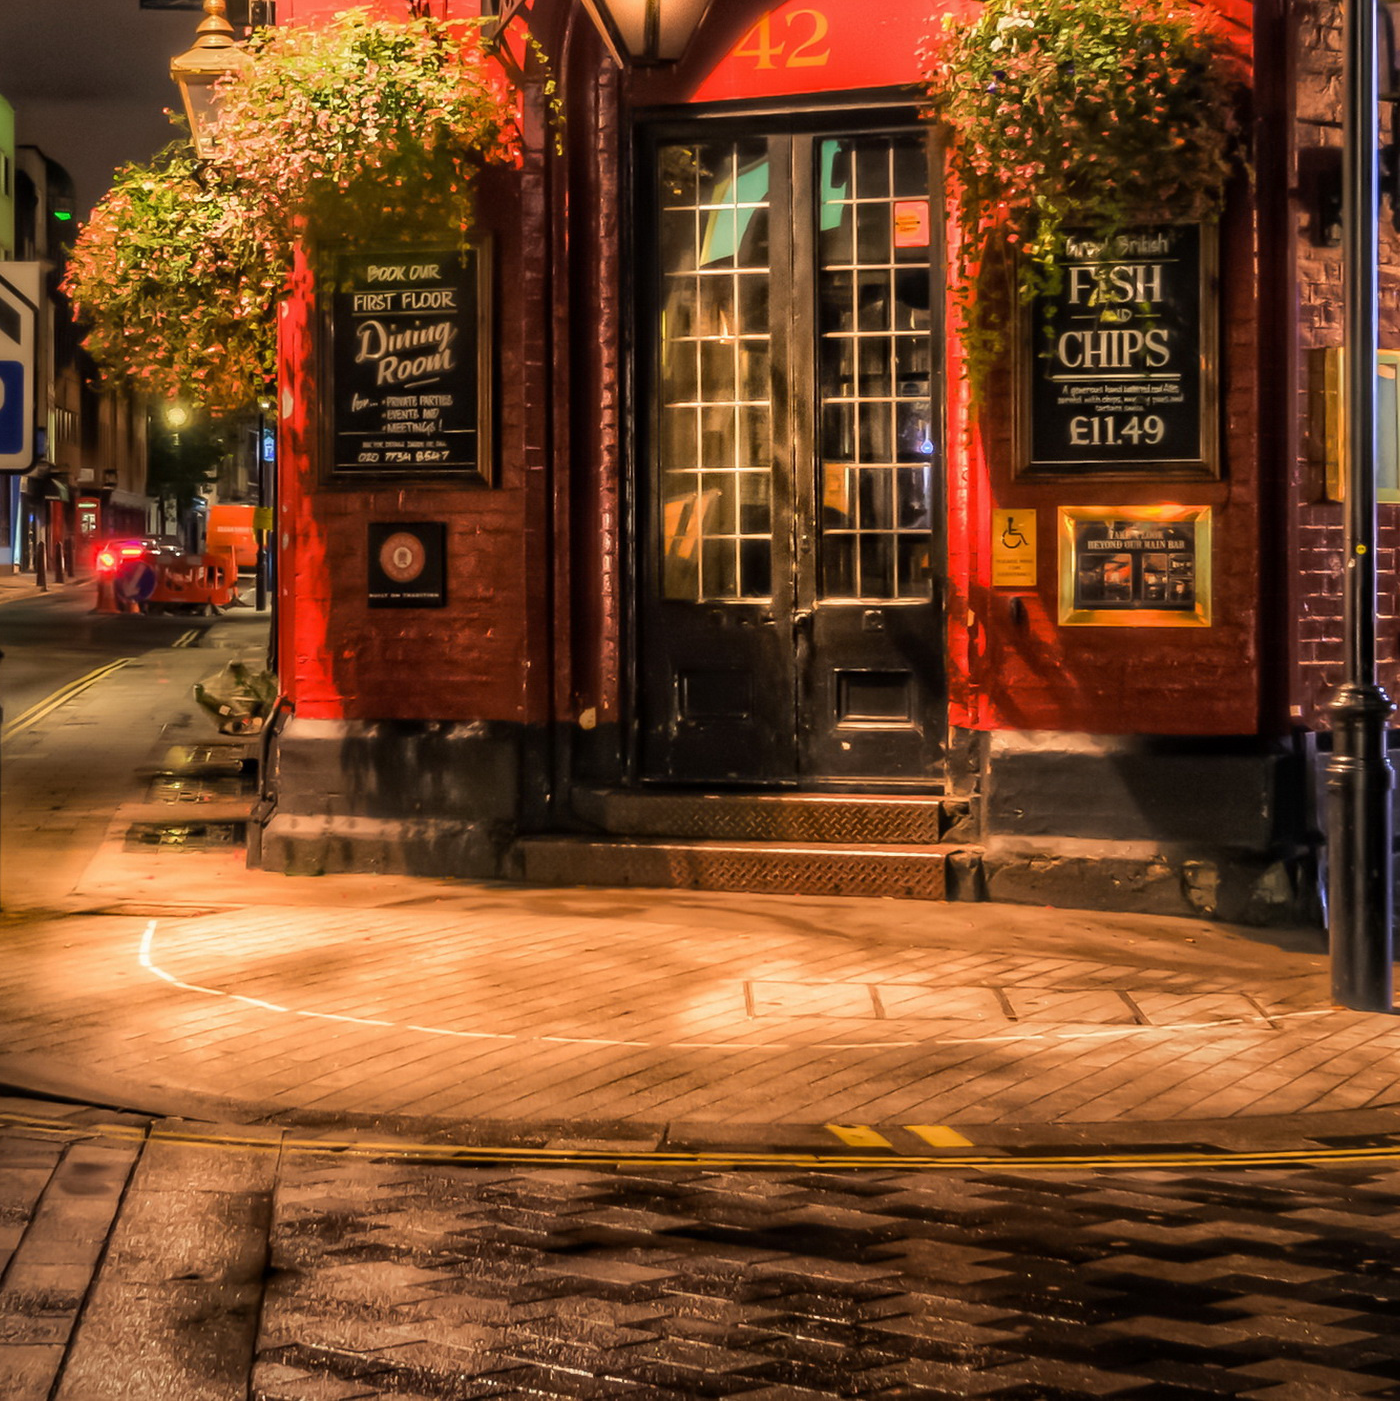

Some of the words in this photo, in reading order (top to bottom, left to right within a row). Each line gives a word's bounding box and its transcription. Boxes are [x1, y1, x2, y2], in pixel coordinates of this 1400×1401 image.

[732, 9, 832, 70] 42
[367, 264, 407, 283] BOOK
[408, 263, 442, 281] OUR
[353, 292, 398, 312] FIRST
[402, 290, 458, 309] FLOOR
[355, 319, 458, 364] Dining
[1058, 328, 1171, 369] CHIPS
[376, 348, 457, 386] Room
[386, 396, 418, 408] PRIVATE
[1069, 414, 1166, 446] £11.49
[1087, 540, 1123, 550] BEYOND
[1124, 540, 1142, 550] OUR
[1144, 540, 1165, 550] MAIN
[1167, 540, 1185, 550] BAR
